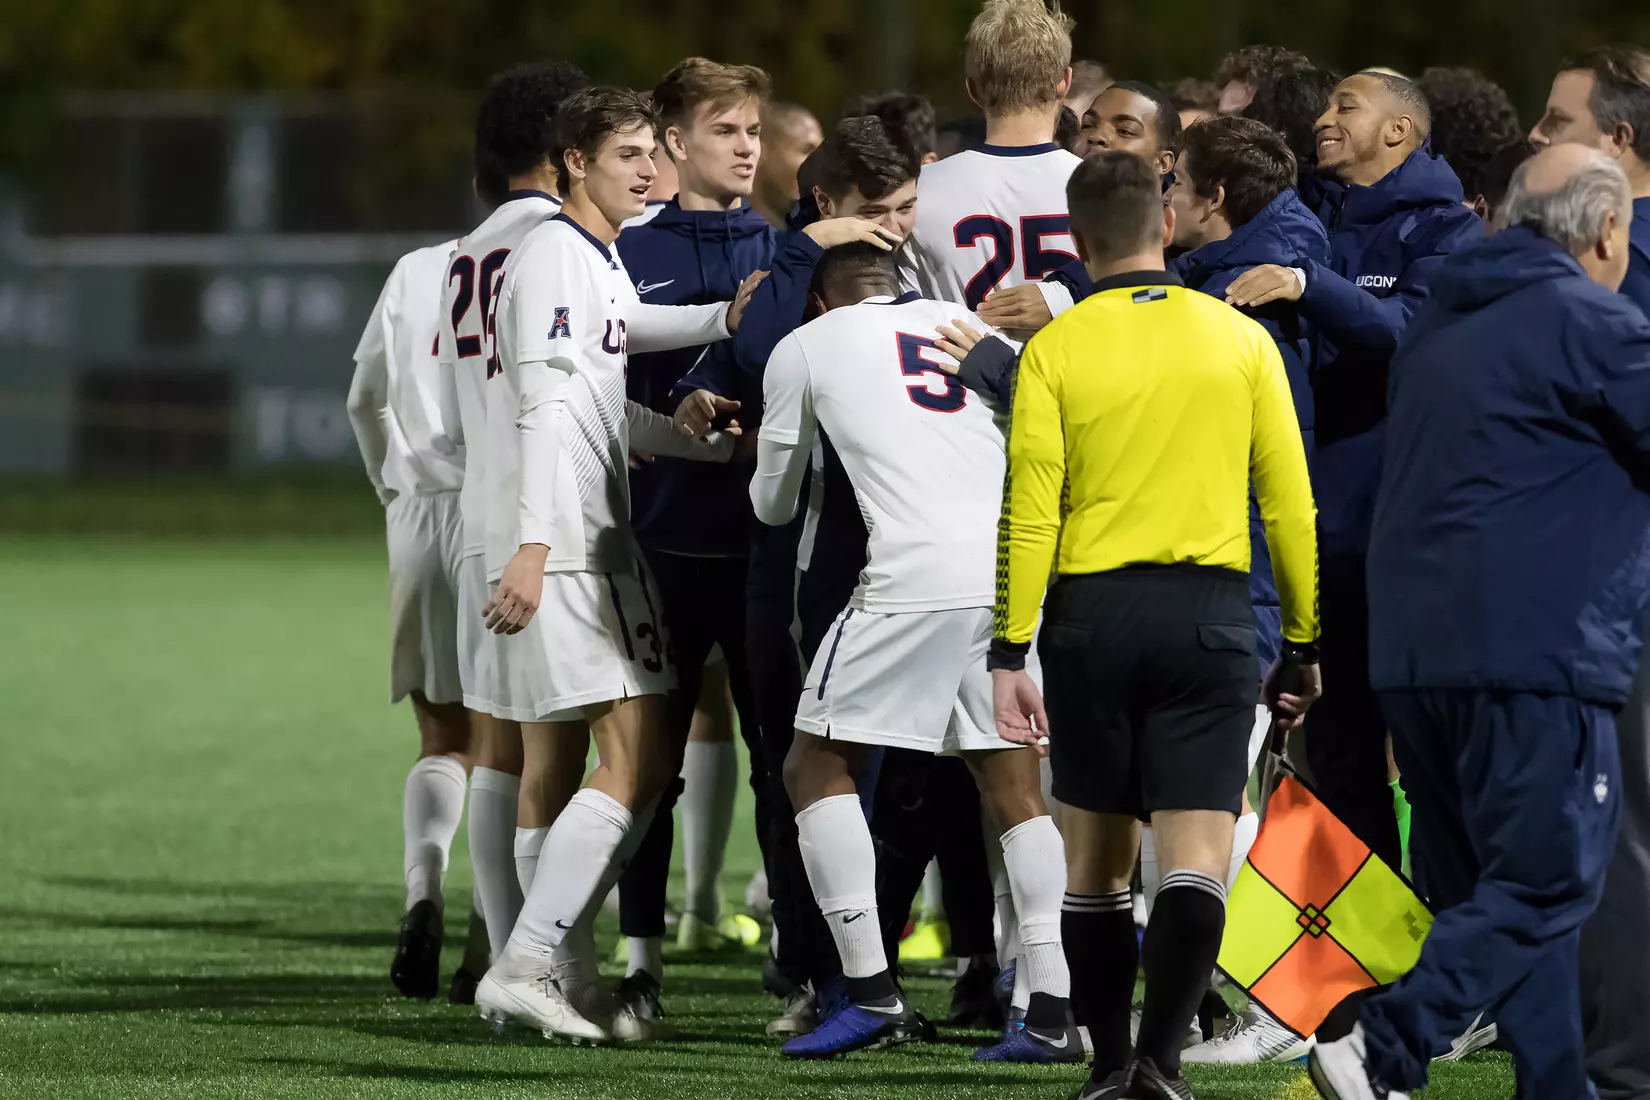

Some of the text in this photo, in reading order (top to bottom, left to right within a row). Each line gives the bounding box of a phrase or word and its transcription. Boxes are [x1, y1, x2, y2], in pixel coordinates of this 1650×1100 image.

[953, 213, 1081, 312] 25
[1355, 275, 1397, 288] UCON
[895, 331, 968, 413] 5
